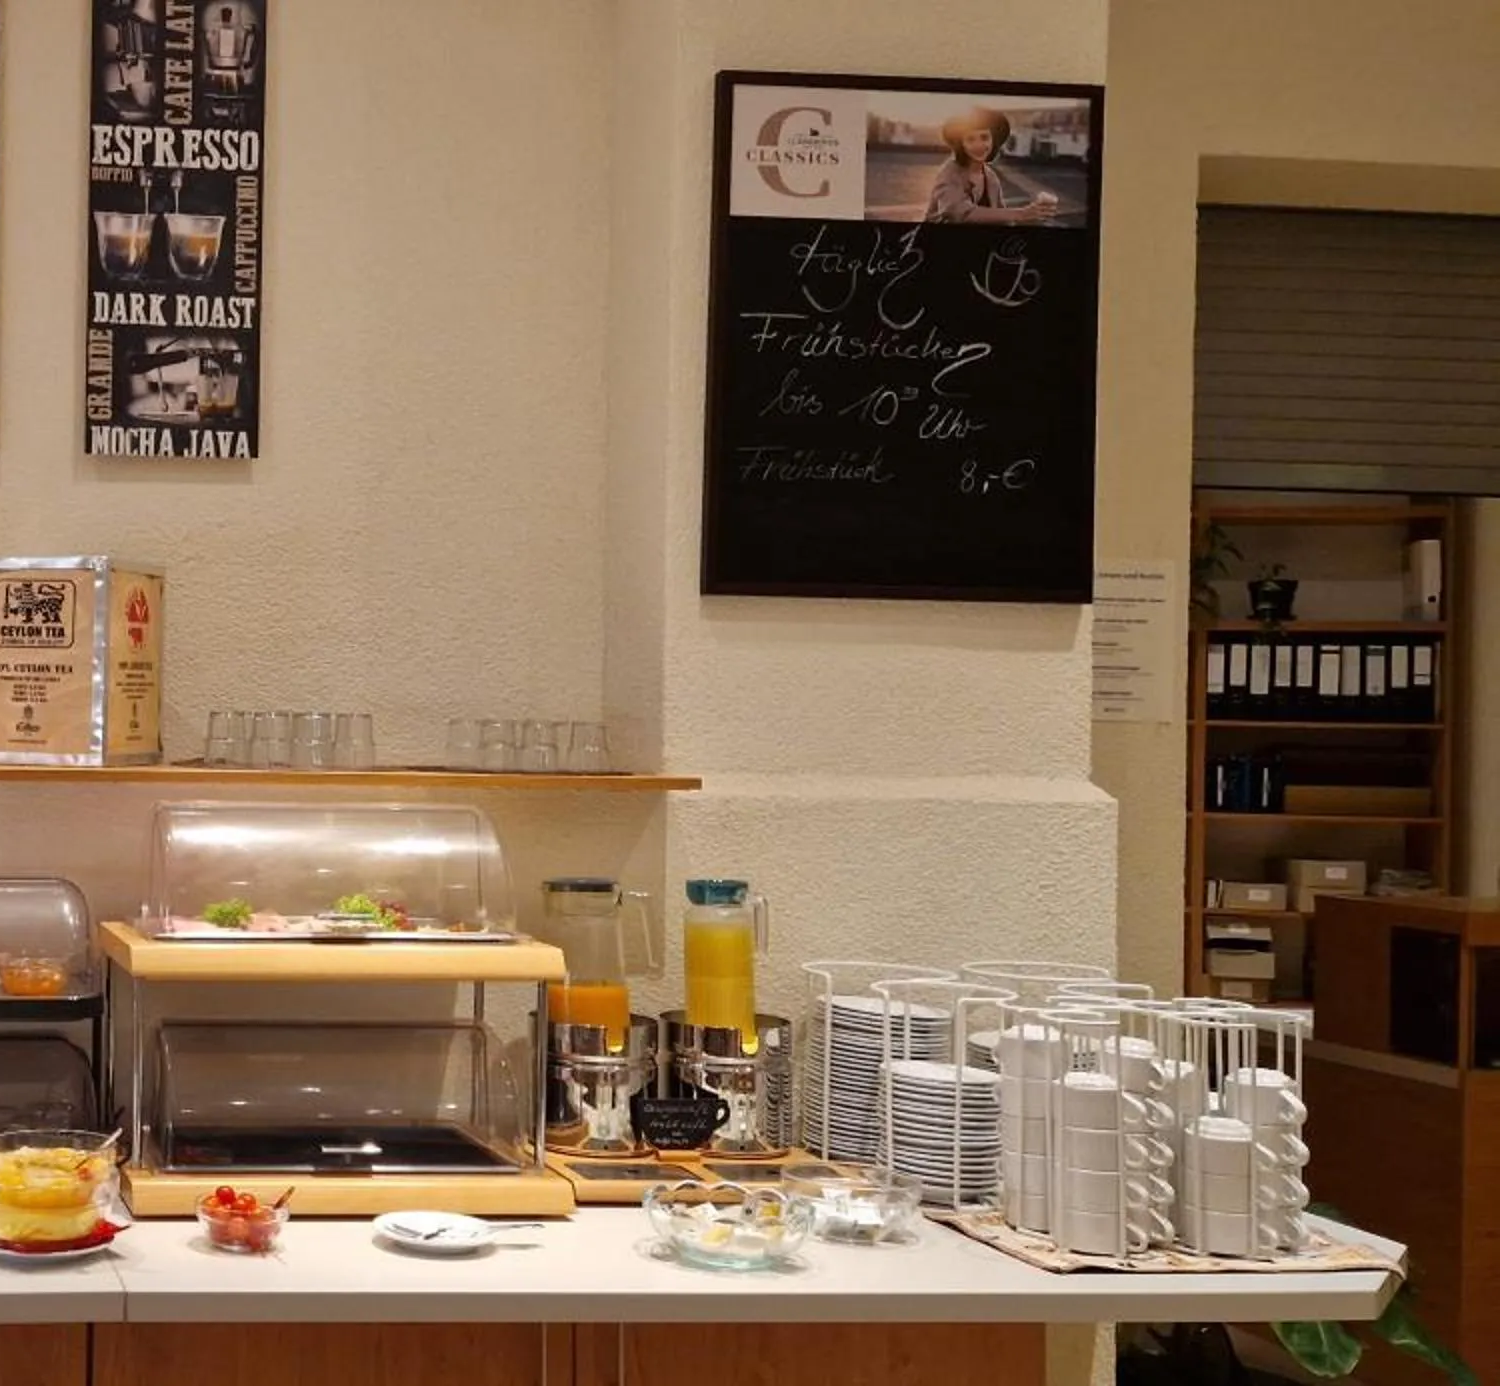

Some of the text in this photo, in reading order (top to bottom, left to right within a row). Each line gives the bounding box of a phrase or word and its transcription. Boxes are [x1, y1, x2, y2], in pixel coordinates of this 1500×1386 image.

[164, 58, 192, 125] CAFE
[92, 124, 259, 172] ESPRESSO
[746, 149, 839, 165] CLASSICS
[235, 175, 258, 293] CAPPUCCINO
[93, 291, 256, 329] DARK ROAST
[88, 328, 113, 421] GRANDE
[919, 404, 988, 439] Uhr
[90, 425, 251, 459] MOCHA JAVA
[0, 625, 65, 638] CEYLON TEA
[14, 663, 51, 673] CEYLON
[55, 664, 74, 674] TEA
